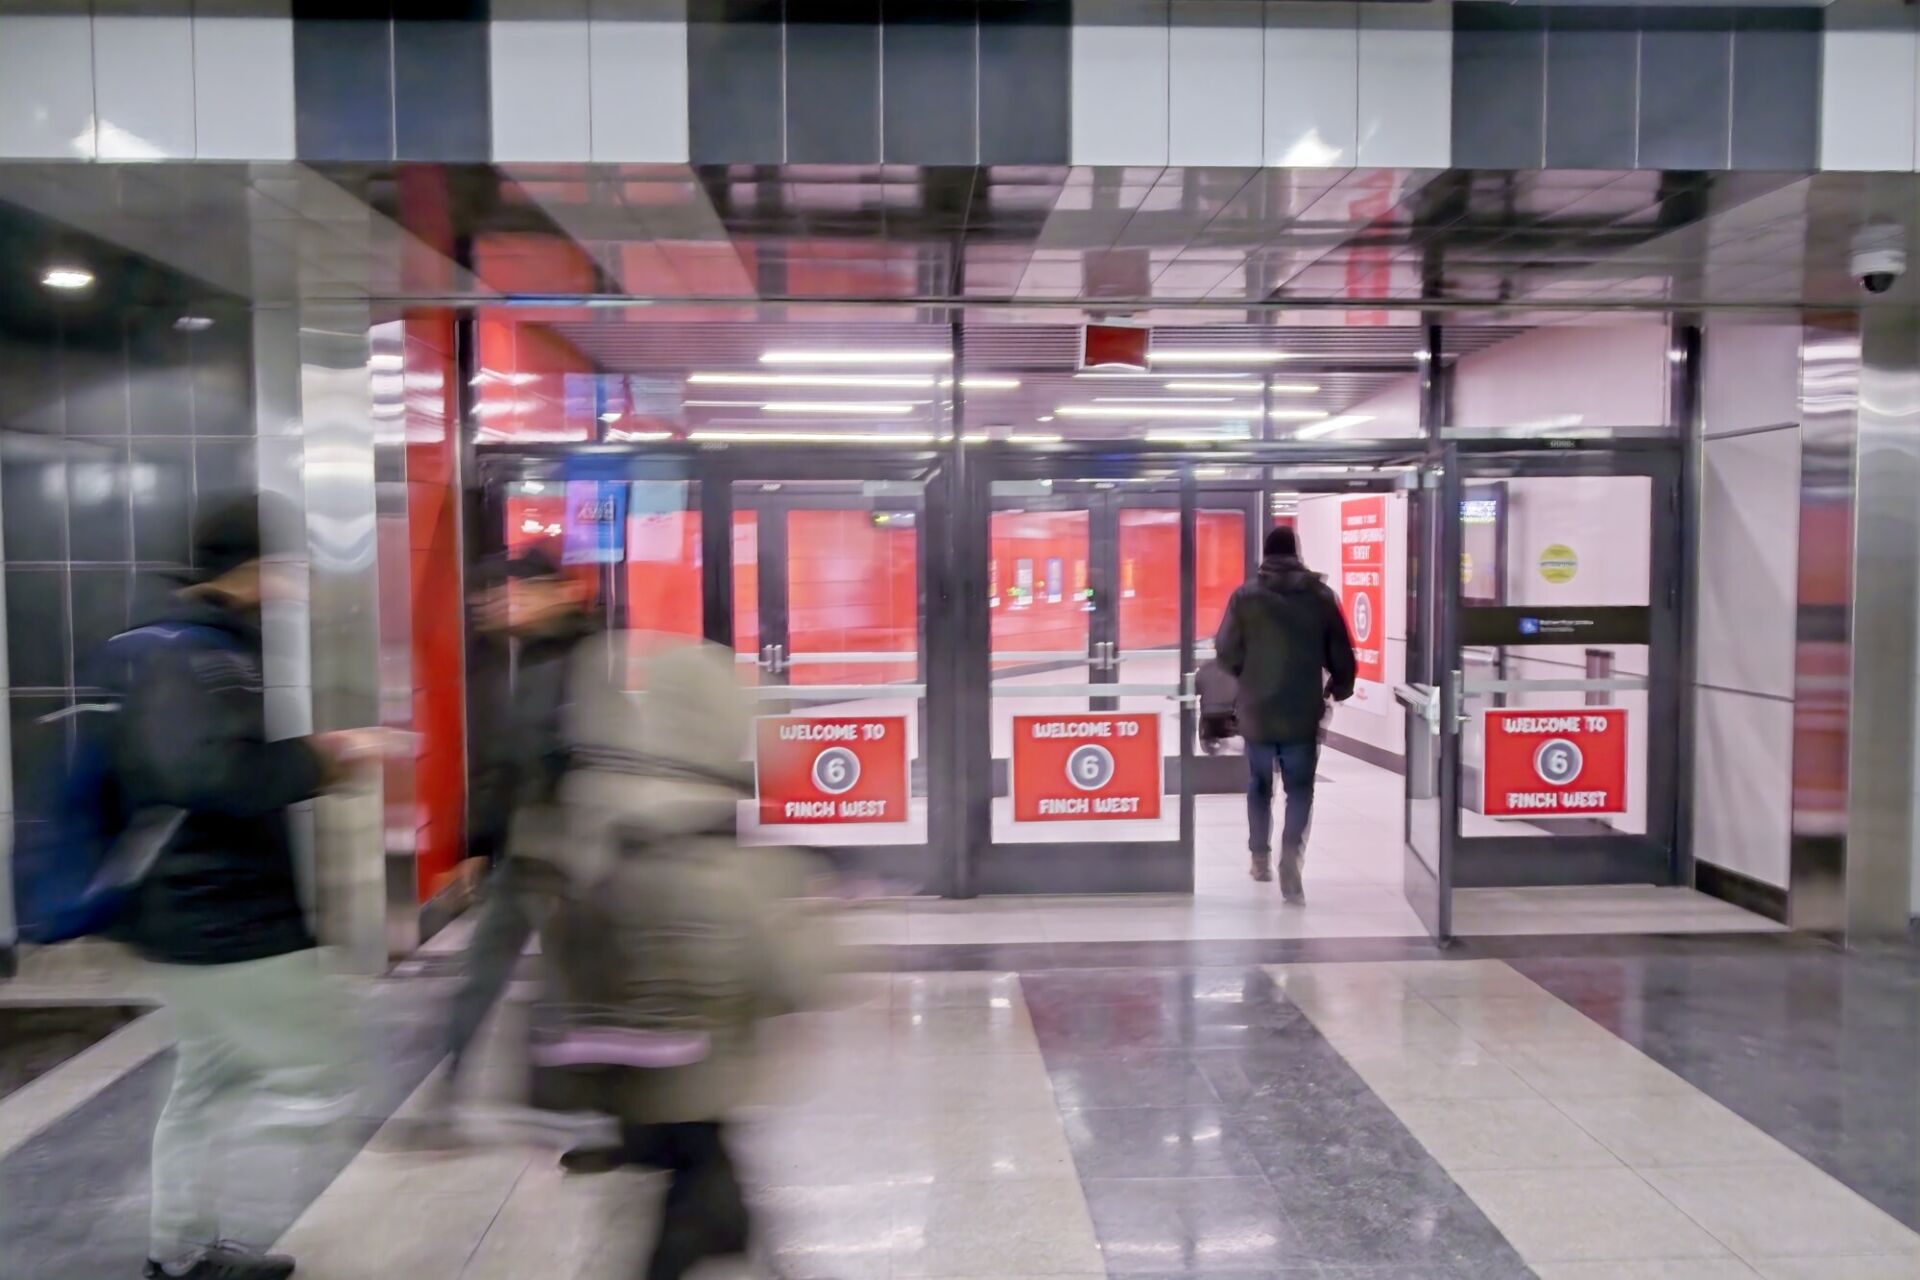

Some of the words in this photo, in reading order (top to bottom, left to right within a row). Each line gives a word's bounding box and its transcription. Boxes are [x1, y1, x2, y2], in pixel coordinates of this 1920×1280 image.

[780, 724, 858, 740] WELCOME
[861, 723, 885, 740] TO
[1032, 722, 1112, 738] WELCOME
[1115, 721, 1139, 737] TO
[1502, 716, 1581, 733] WELCOME
[1583, 716, 1608, 732] TO
[827, 757, 846, 784] 6
[1081, 755, 1100, 780] 6
[1550, 750, 1569, 775] 6
[785, 801, 836, 818] FINCH
[840, 800, 887, 816] WEST
[1038, 798, 1089, 815] FINCH
[1093, 797, 1140, 813] WEST
[1506, 792, 1557, 809] FINCH
[1559, 791, 1607, 808] WEST
